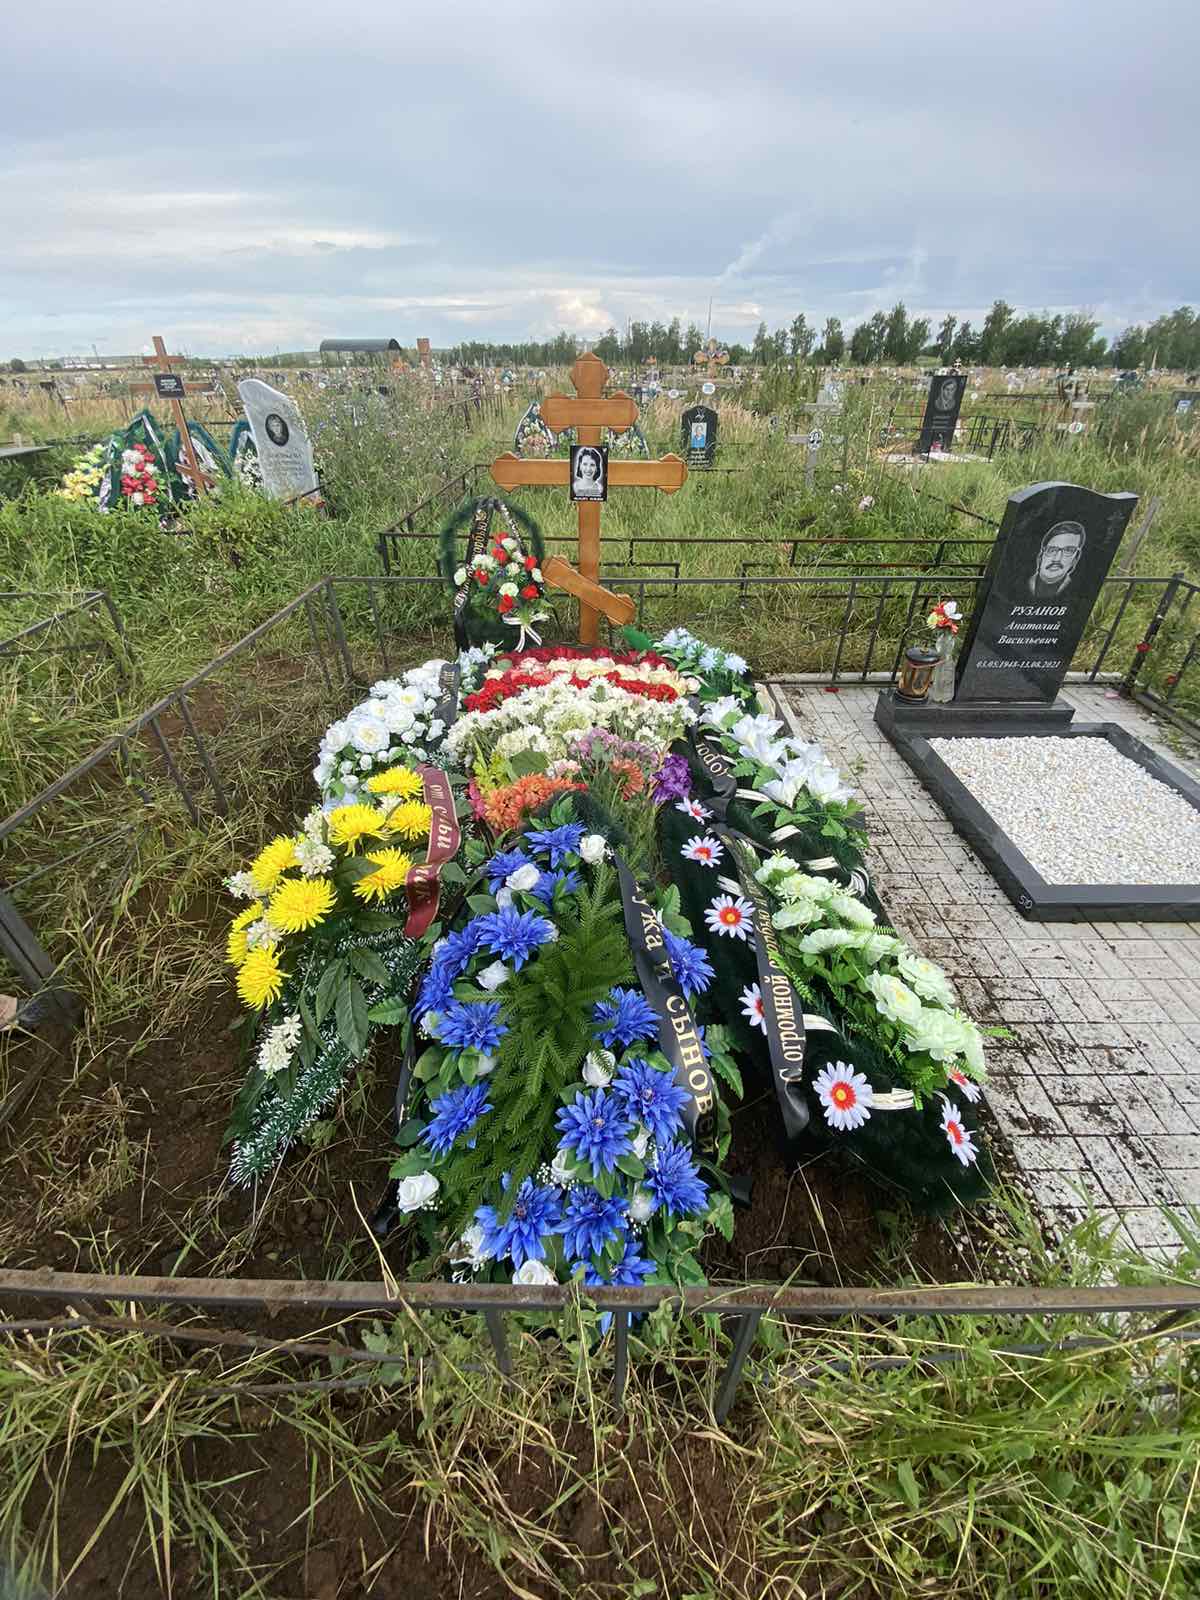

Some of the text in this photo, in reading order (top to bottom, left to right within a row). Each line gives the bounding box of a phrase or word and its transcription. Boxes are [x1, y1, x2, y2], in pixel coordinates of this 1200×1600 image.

[1010, 605, 1067, 616] РУЗАНОВ
[1004, 620, 1061, 631] Анатолий
[997, 634, 1059, 645] Васильевич
[631, 881, 665, 952] ужа
[655, 960, 673, 983] и
[764, 975, 804, 1061] огромной
[778, 1066, 803, 1085] С
